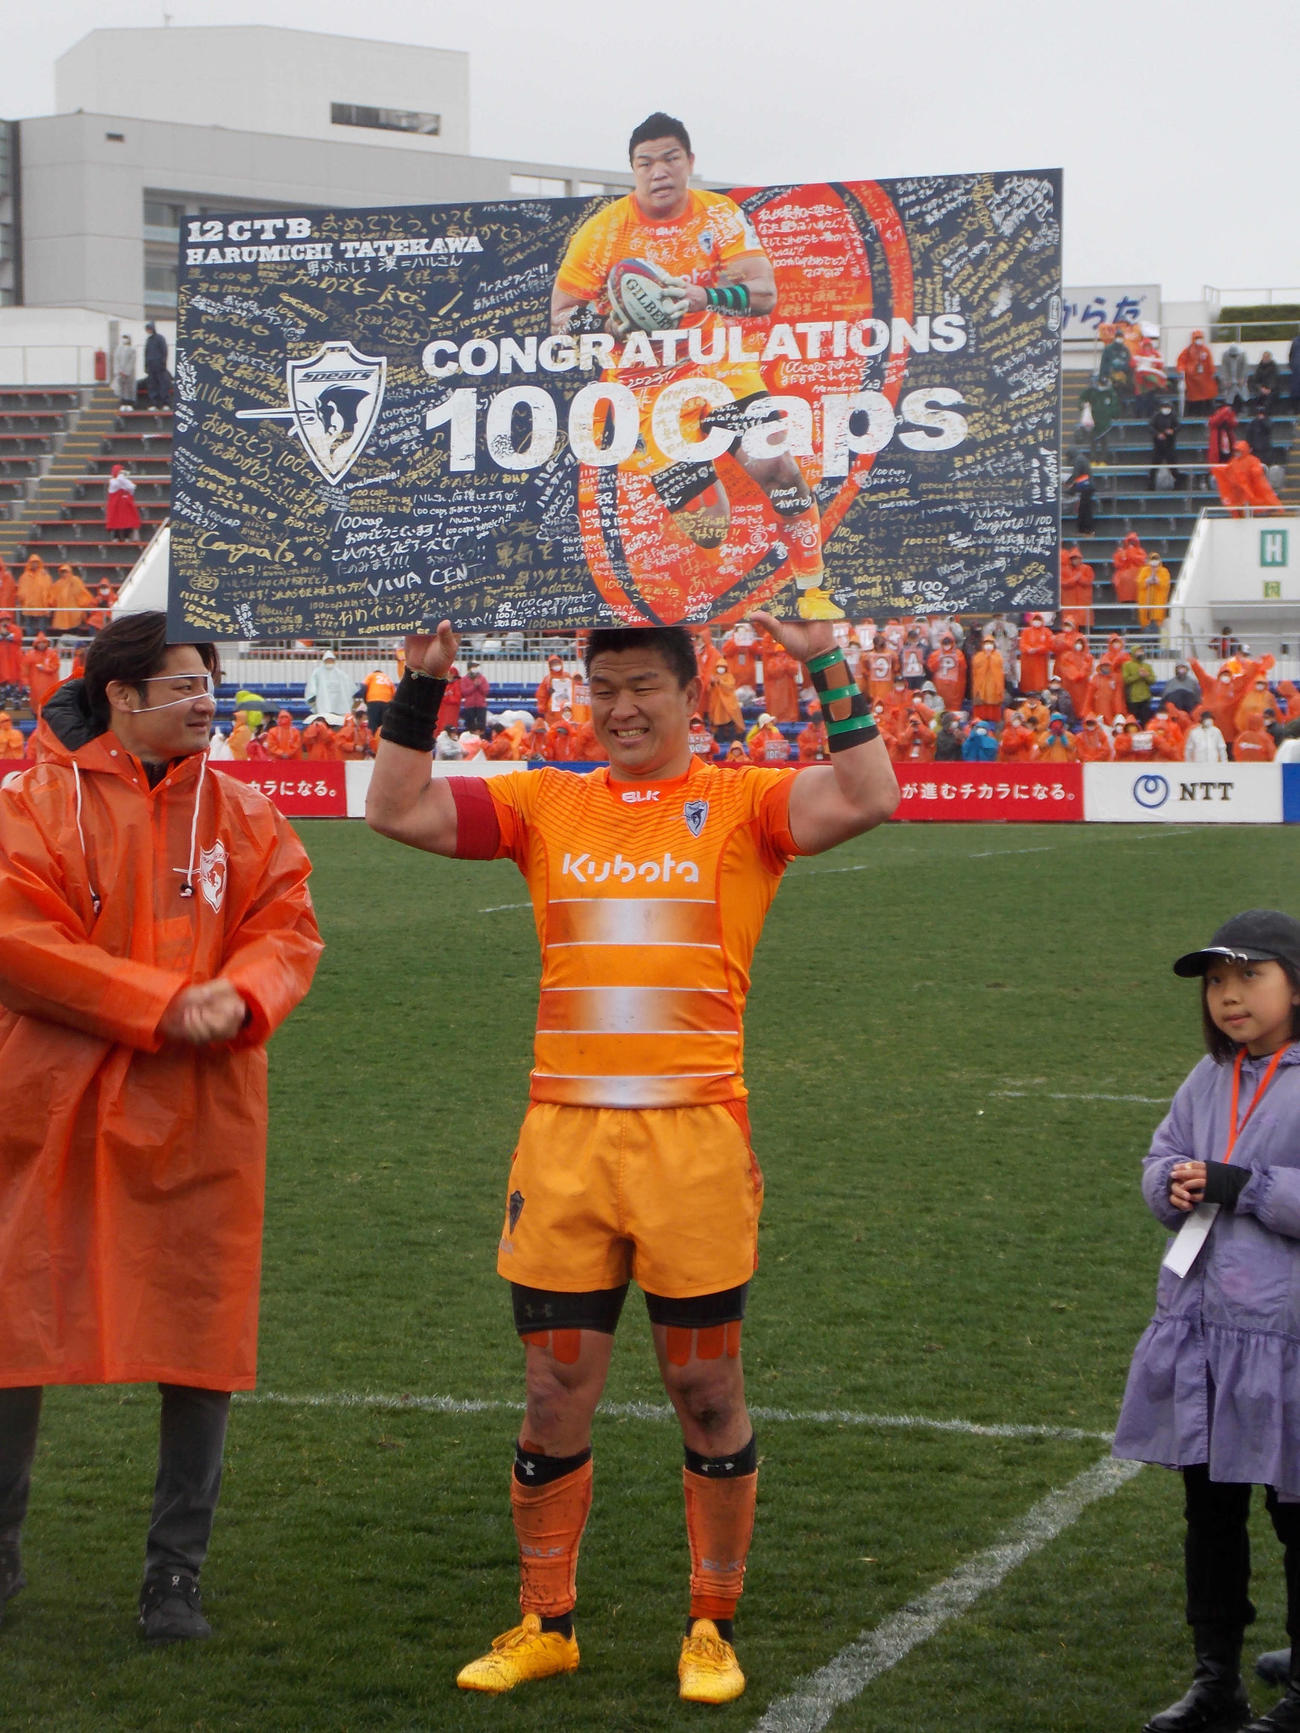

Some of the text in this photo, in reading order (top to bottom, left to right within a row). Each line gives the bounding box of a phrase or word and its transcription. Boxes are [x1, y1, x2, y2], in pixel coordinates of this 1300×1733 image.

[186, 236, 484, 265] HARUMICHI TATEKAWA
[421, 313, 968, 378] CONGRATULATIONS
[426, 382, 968, 478] 100 Caps
[1265, 534, 1283, 562] H
[366, 570, 423, 598] VIVA
[621, 791, 661, 803] BLK
[902, 782, 1076, 801] が進むチカラになる。
[1180, 782, 1233, 801] NTT
[562, 853, 699, 883] Kubota
